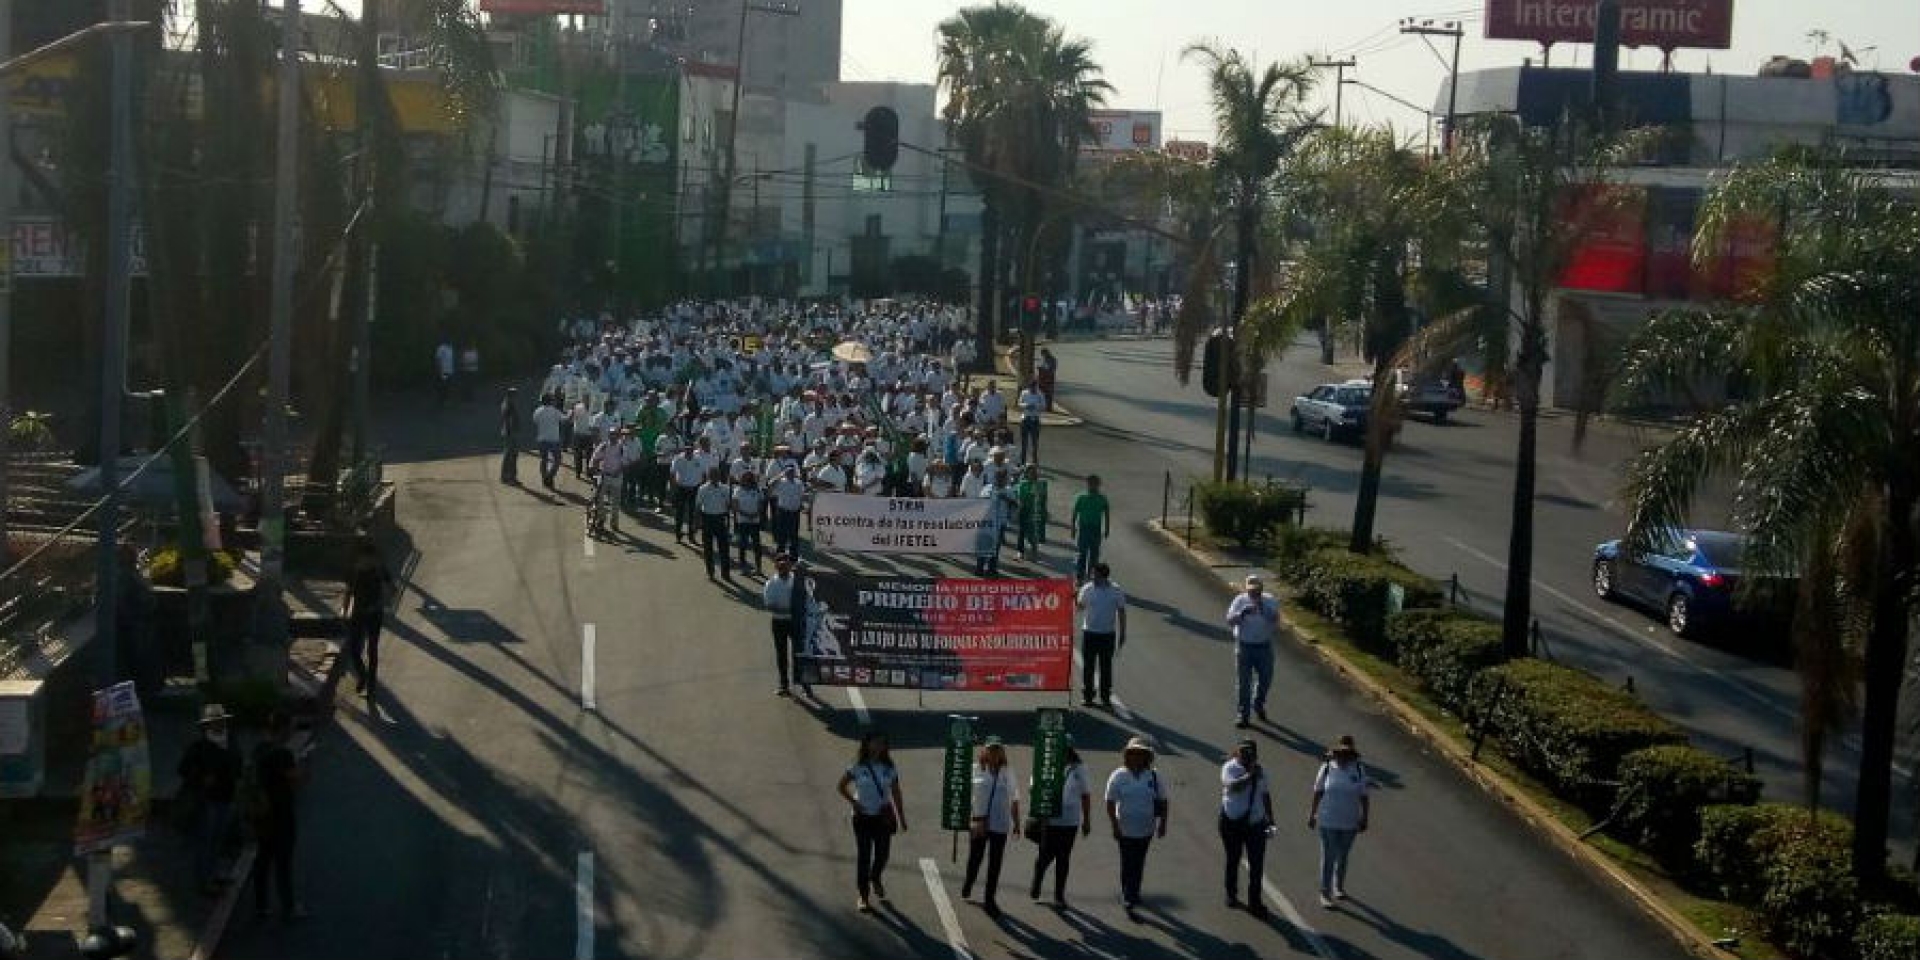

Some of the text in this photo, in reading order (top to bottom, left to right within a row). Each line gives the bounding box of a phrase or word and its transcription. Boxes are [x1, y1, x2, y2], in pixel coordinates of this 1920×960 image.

[816, 515, 831, 526] en
[834, 515, 874, 528] contra
[878, 514, 893, 528] de
[872, 533, 938, 547] del IFETEL
[858, 590, 1060, 611] PRIMERO DE MAYO
[898, 632, 918, 649] LAS
